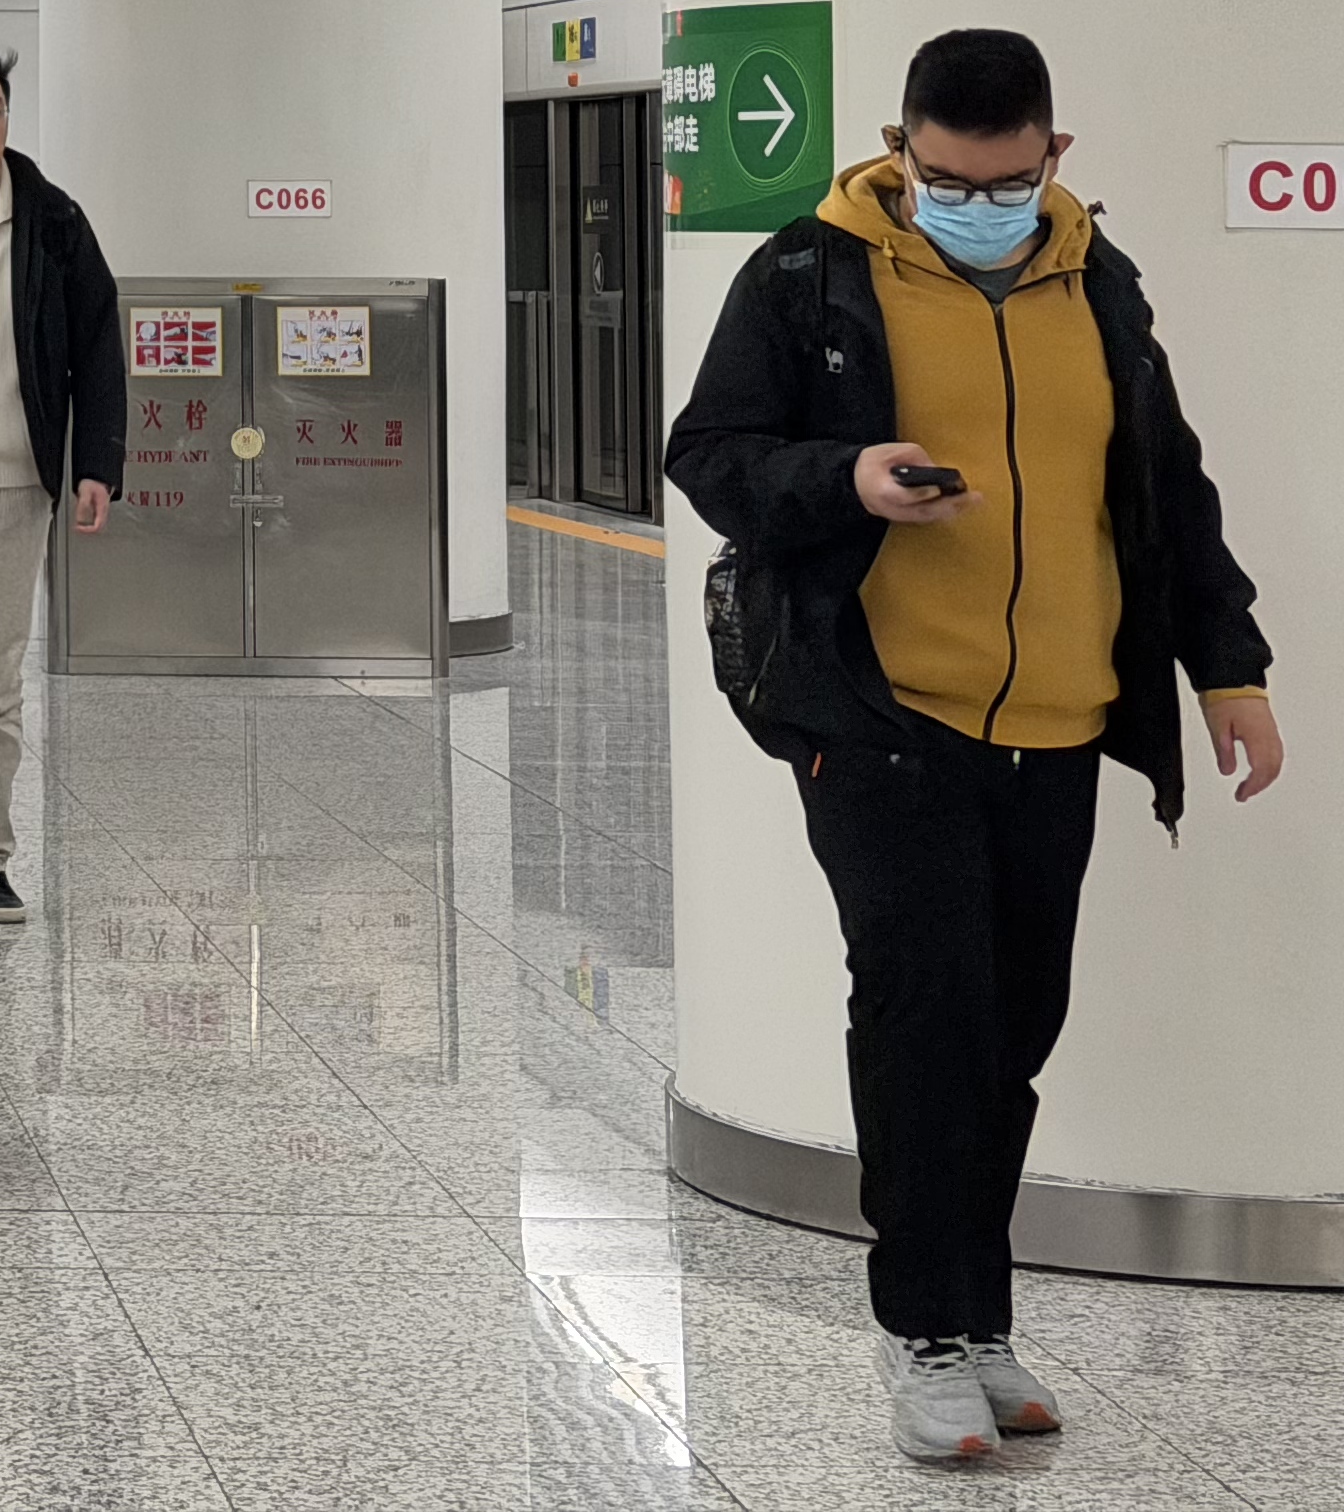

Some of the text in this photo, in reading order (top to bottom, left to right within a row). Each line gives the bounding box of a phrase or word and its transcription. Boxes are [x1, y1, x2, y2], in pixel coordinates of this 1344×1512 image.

[255, 187, 326, 211] C066
[296, 419, 403, 447] 灭火器
